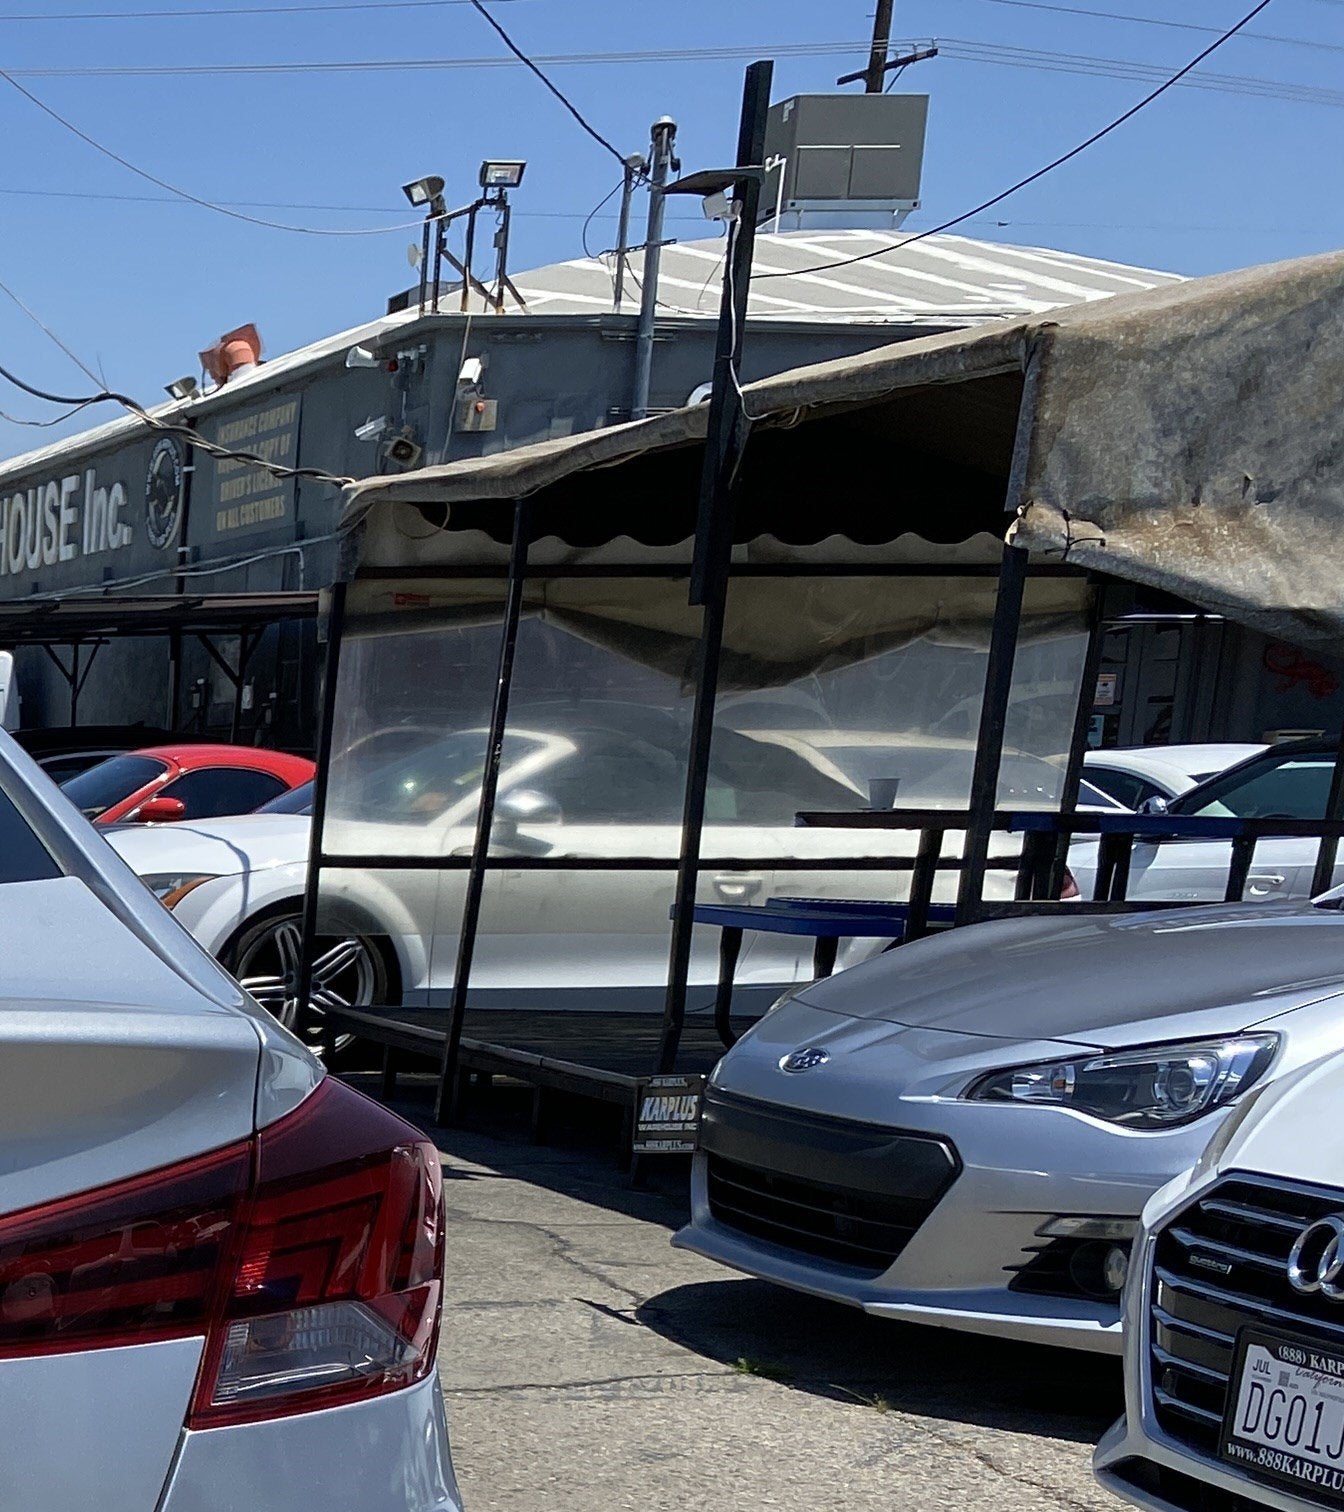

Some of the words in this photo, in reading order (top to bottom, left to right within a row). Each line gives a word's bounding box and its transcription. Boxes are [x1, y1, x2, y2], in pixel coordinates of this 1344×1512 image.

[258, 401, 297, 432] COMPANY
[83, 468, 133, 555] Inc.
[640, 1095, 699, 1121] KARPLUS
[1252, 1359, 1271, 1375] JUL
[1278, 1345, 1306, 1365] (888)
[1227, 1442, 1344, 1490] www.888KARPLU
